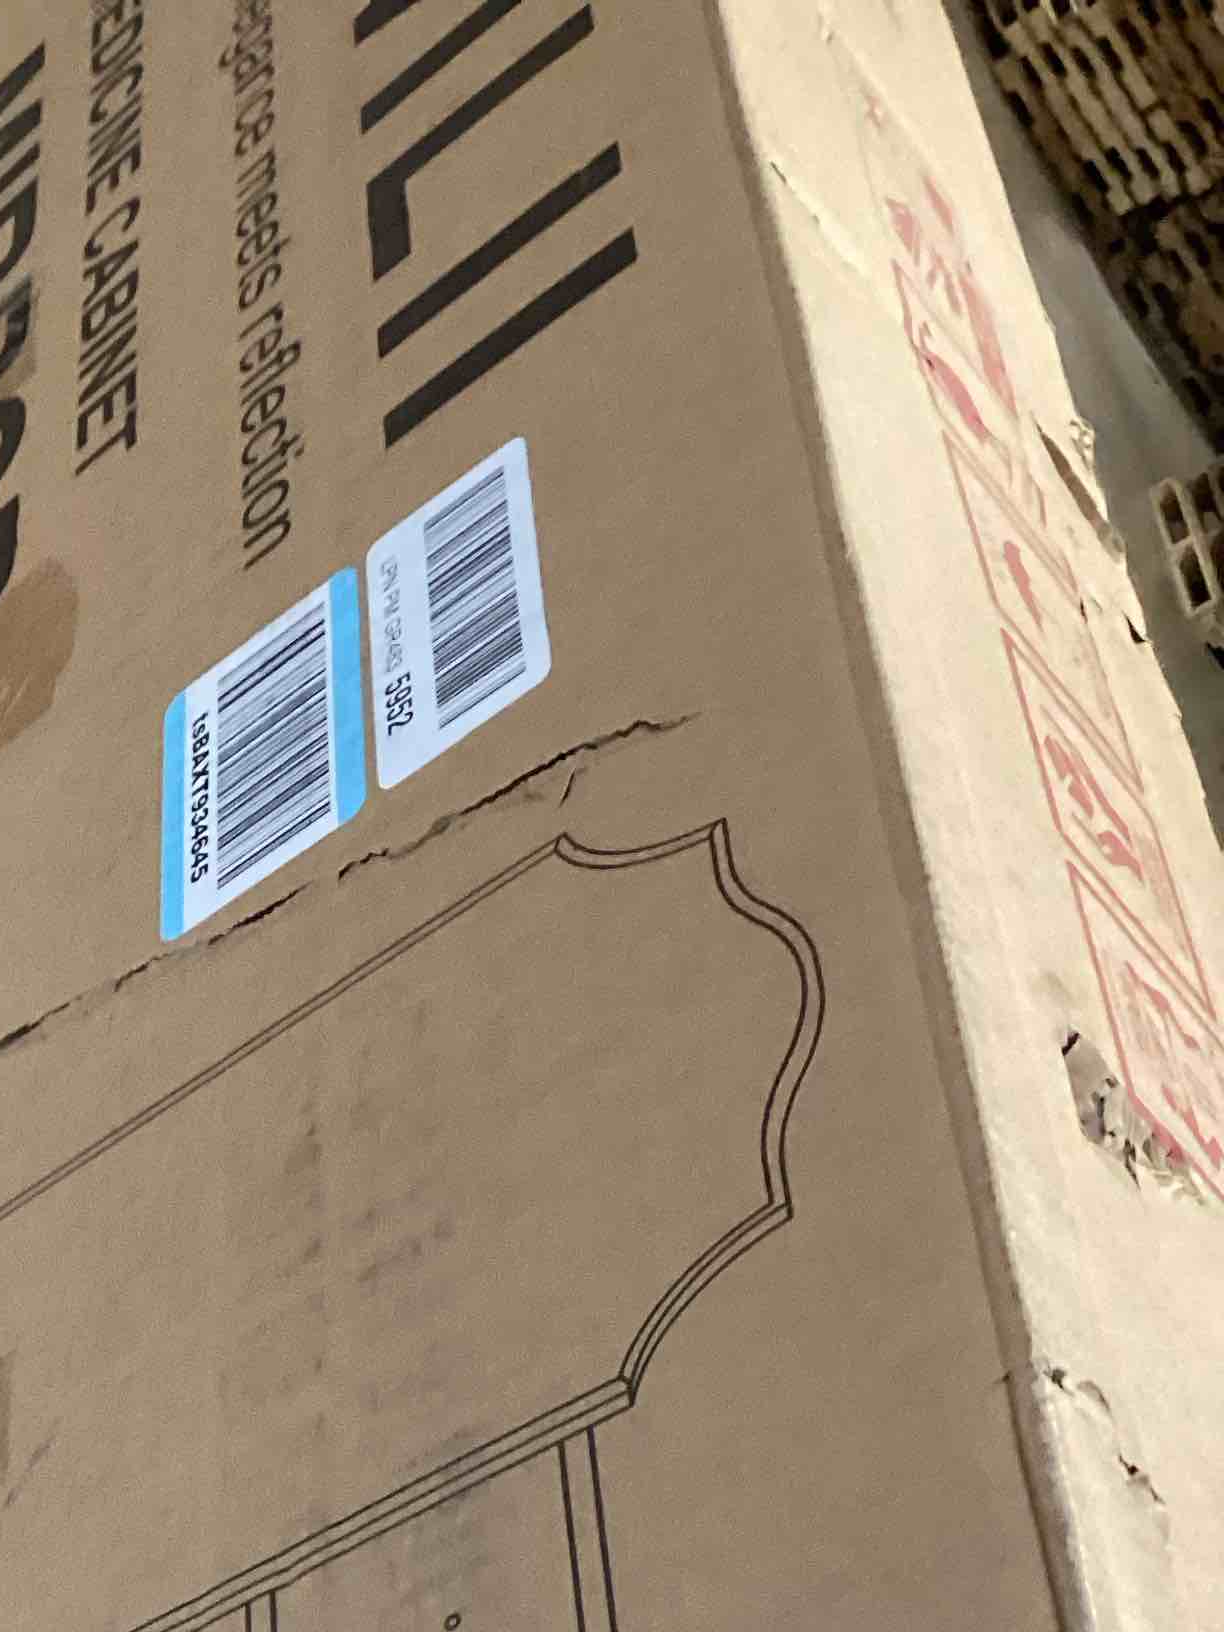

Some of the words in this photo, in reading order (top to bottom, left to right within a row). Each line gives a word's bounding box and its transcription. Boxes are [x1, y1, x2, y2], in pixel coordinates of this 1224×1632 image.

[84, 0, 145, 217] EDICINE
[235, 148, 291, 313] meets
[74, 194, 142, 478] CABINET
[238, 301, 305, 572] reflection
[189, 712, 210, 885] tsBAXT934645
[384, 671, 415, 737] 5952
